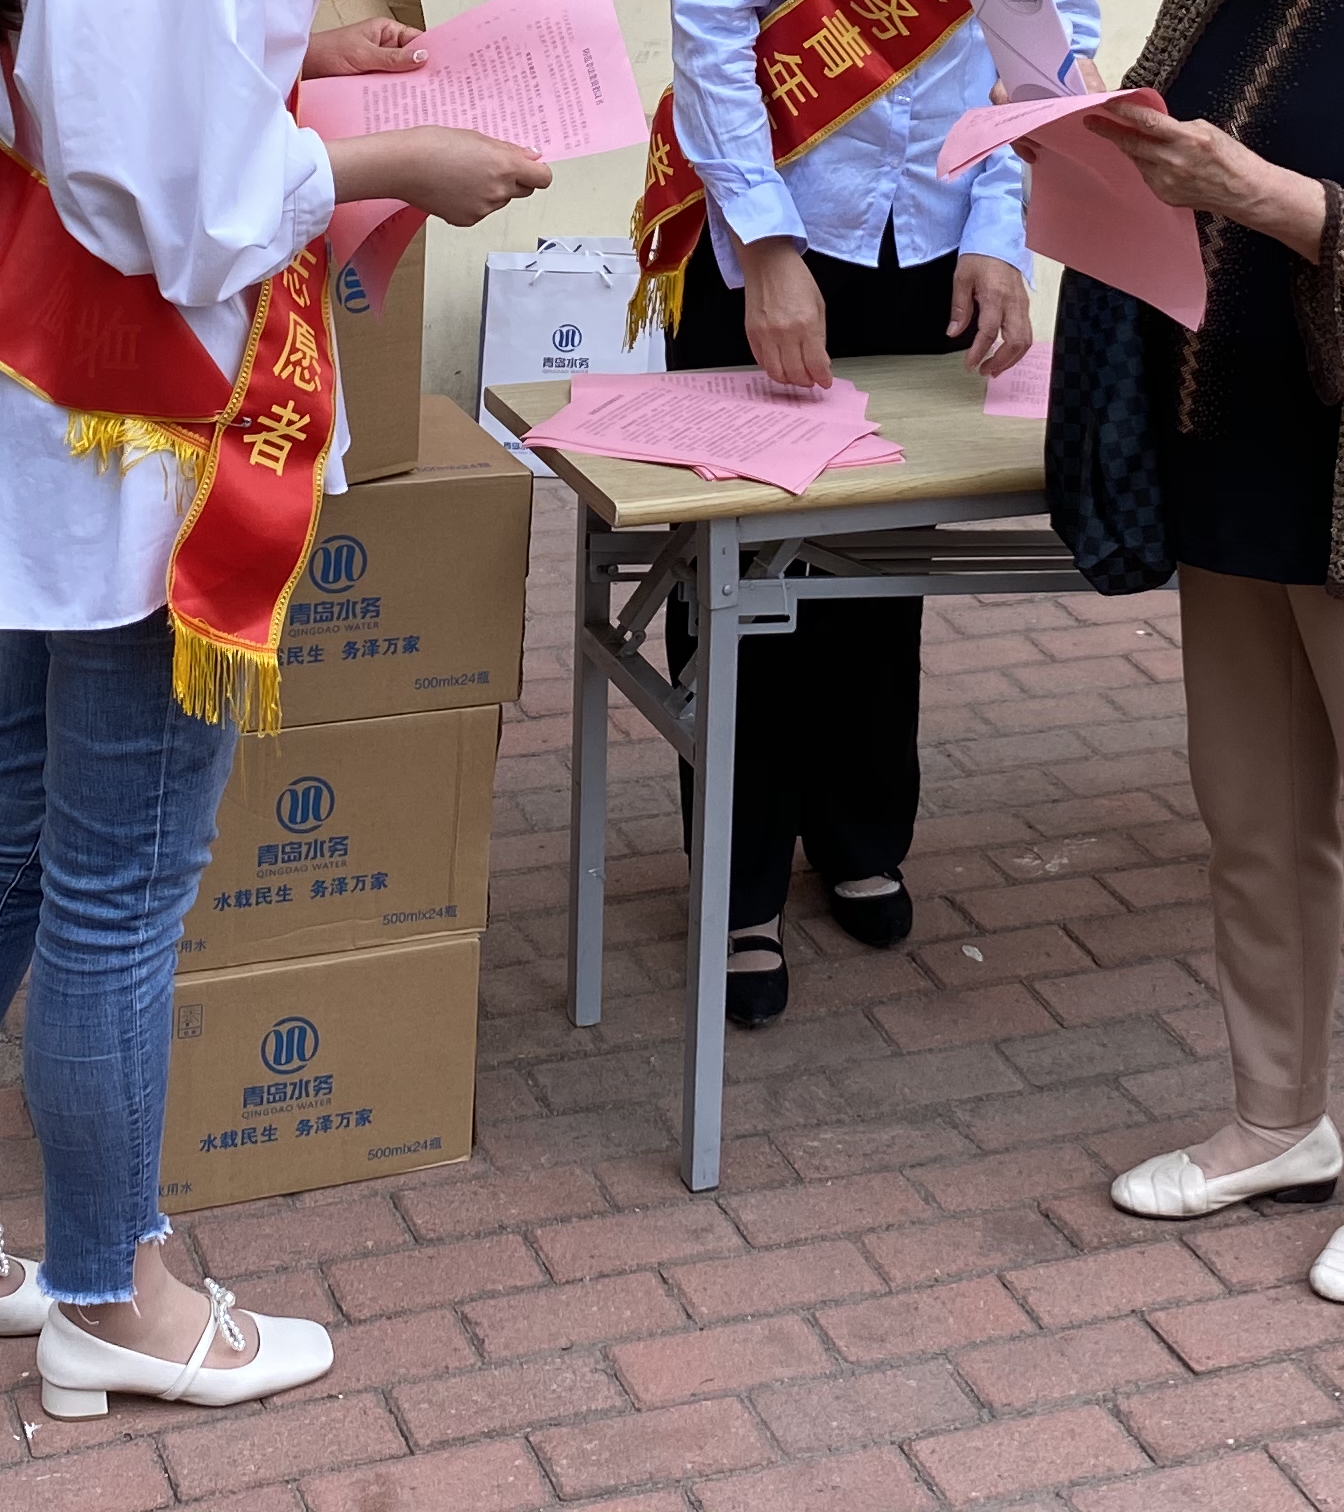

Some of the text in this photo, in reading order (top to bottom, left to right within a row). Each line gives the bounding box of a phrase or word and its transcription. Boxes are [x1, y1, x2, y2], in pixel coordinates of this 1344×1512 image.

[542, 357, 590, 369] 青岛水务
[289, 597, 381, 626] 青岛水务
[288, 620, 379, 637] QINGDAO WATER
[342, 635, 421, 661] 务泽万家
[257, 835, 349, 868] 青岛水务
[256, 859, 348, 879] QINGDAO WATER
[213, 871, 389, 913] 水载民生 务泽万家
[175, 938, 207, 954] 用水
[242, 1074, 334, 1109] 青岛水务
[241, 1097, 332, 1120] QINGDAO WATER
[199, 1107, 374, 1154] 水载民生 务泽万家
